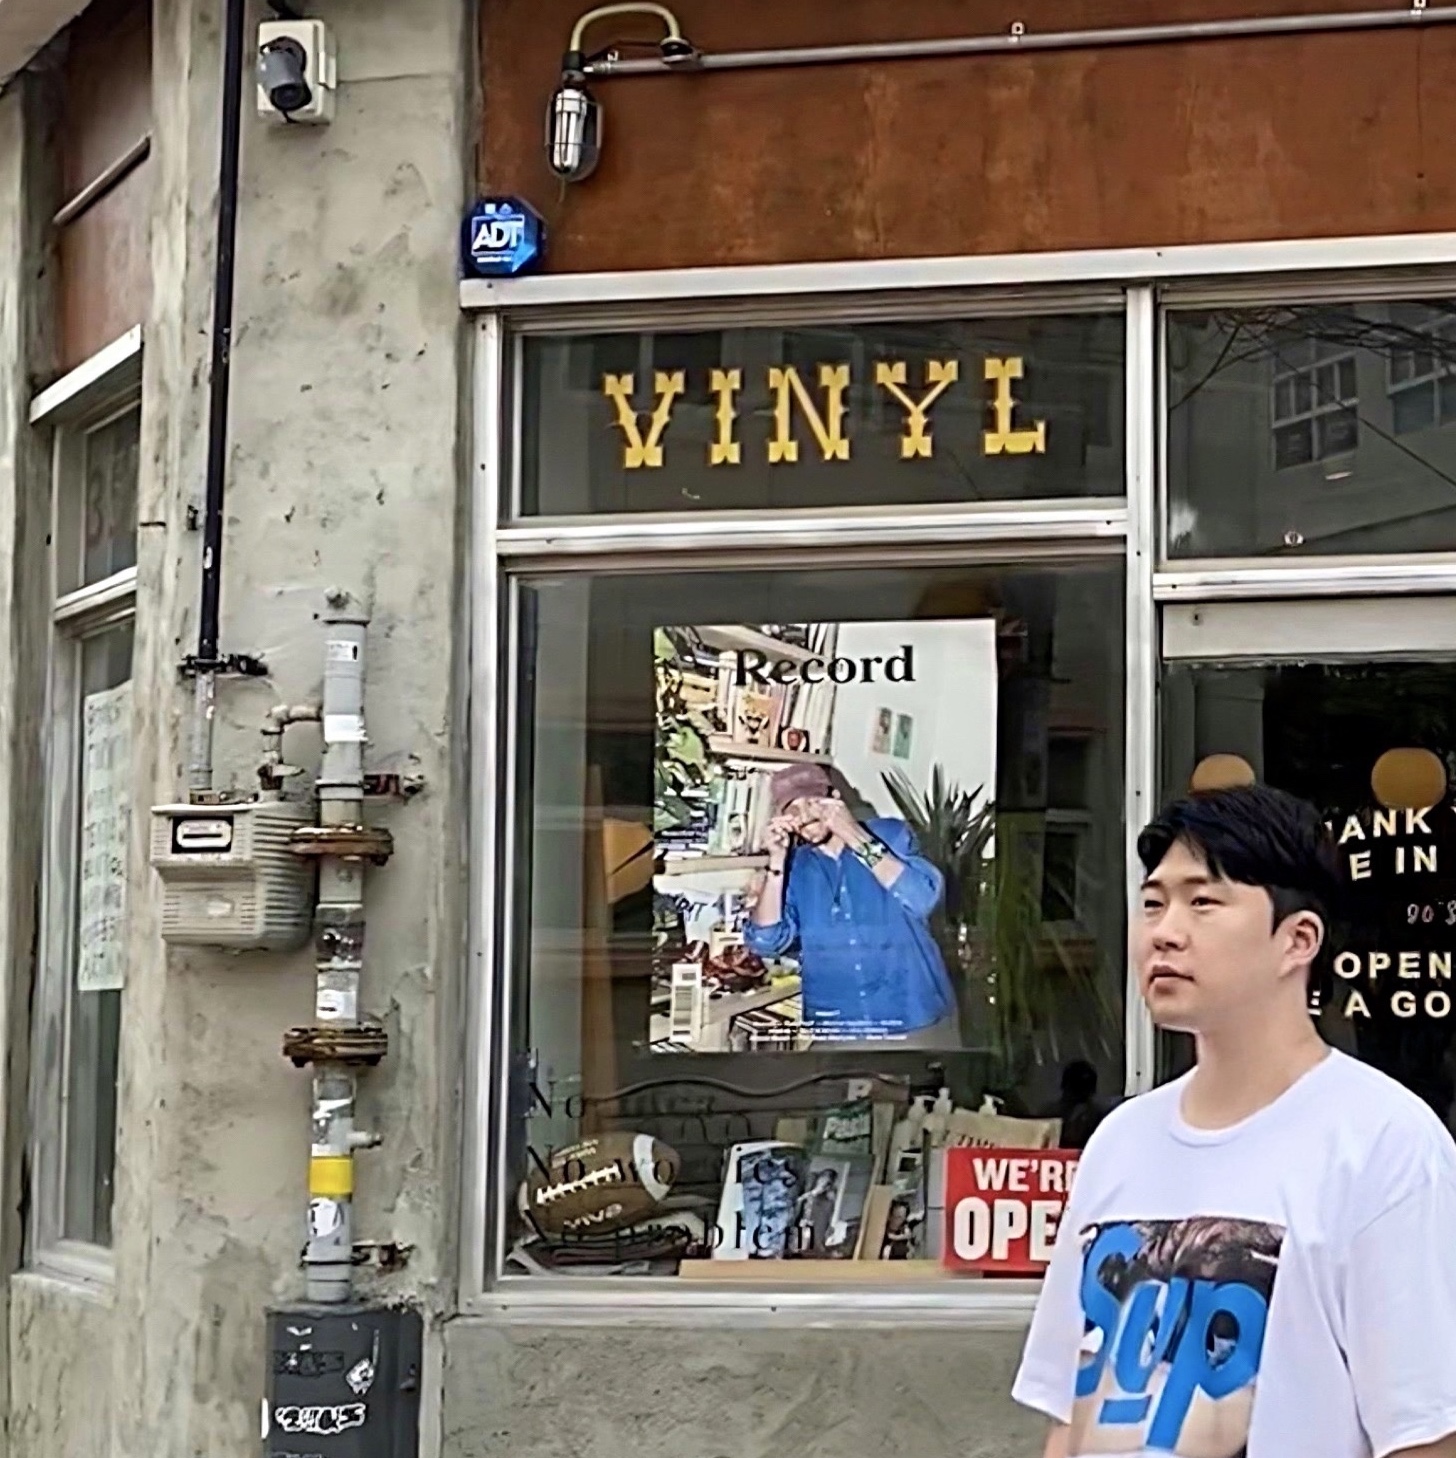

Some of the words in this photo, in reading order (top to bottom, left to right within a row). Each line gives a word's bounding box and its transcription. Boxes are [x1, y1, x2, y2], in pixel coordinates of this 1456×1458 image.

[472, 221, 524, 250] ADT
[603, 356, 1047, 469] VINYL
[733, 644, 916, 687] Record
[1324, 807, 1432, 846] ANK
[1395, 846, 1438, 875] IN
[1333, 951, 1453, 980] OPEN
[1344, 990, 1371, 1019] A
[953, 1196, 1064, 1261] OPE
